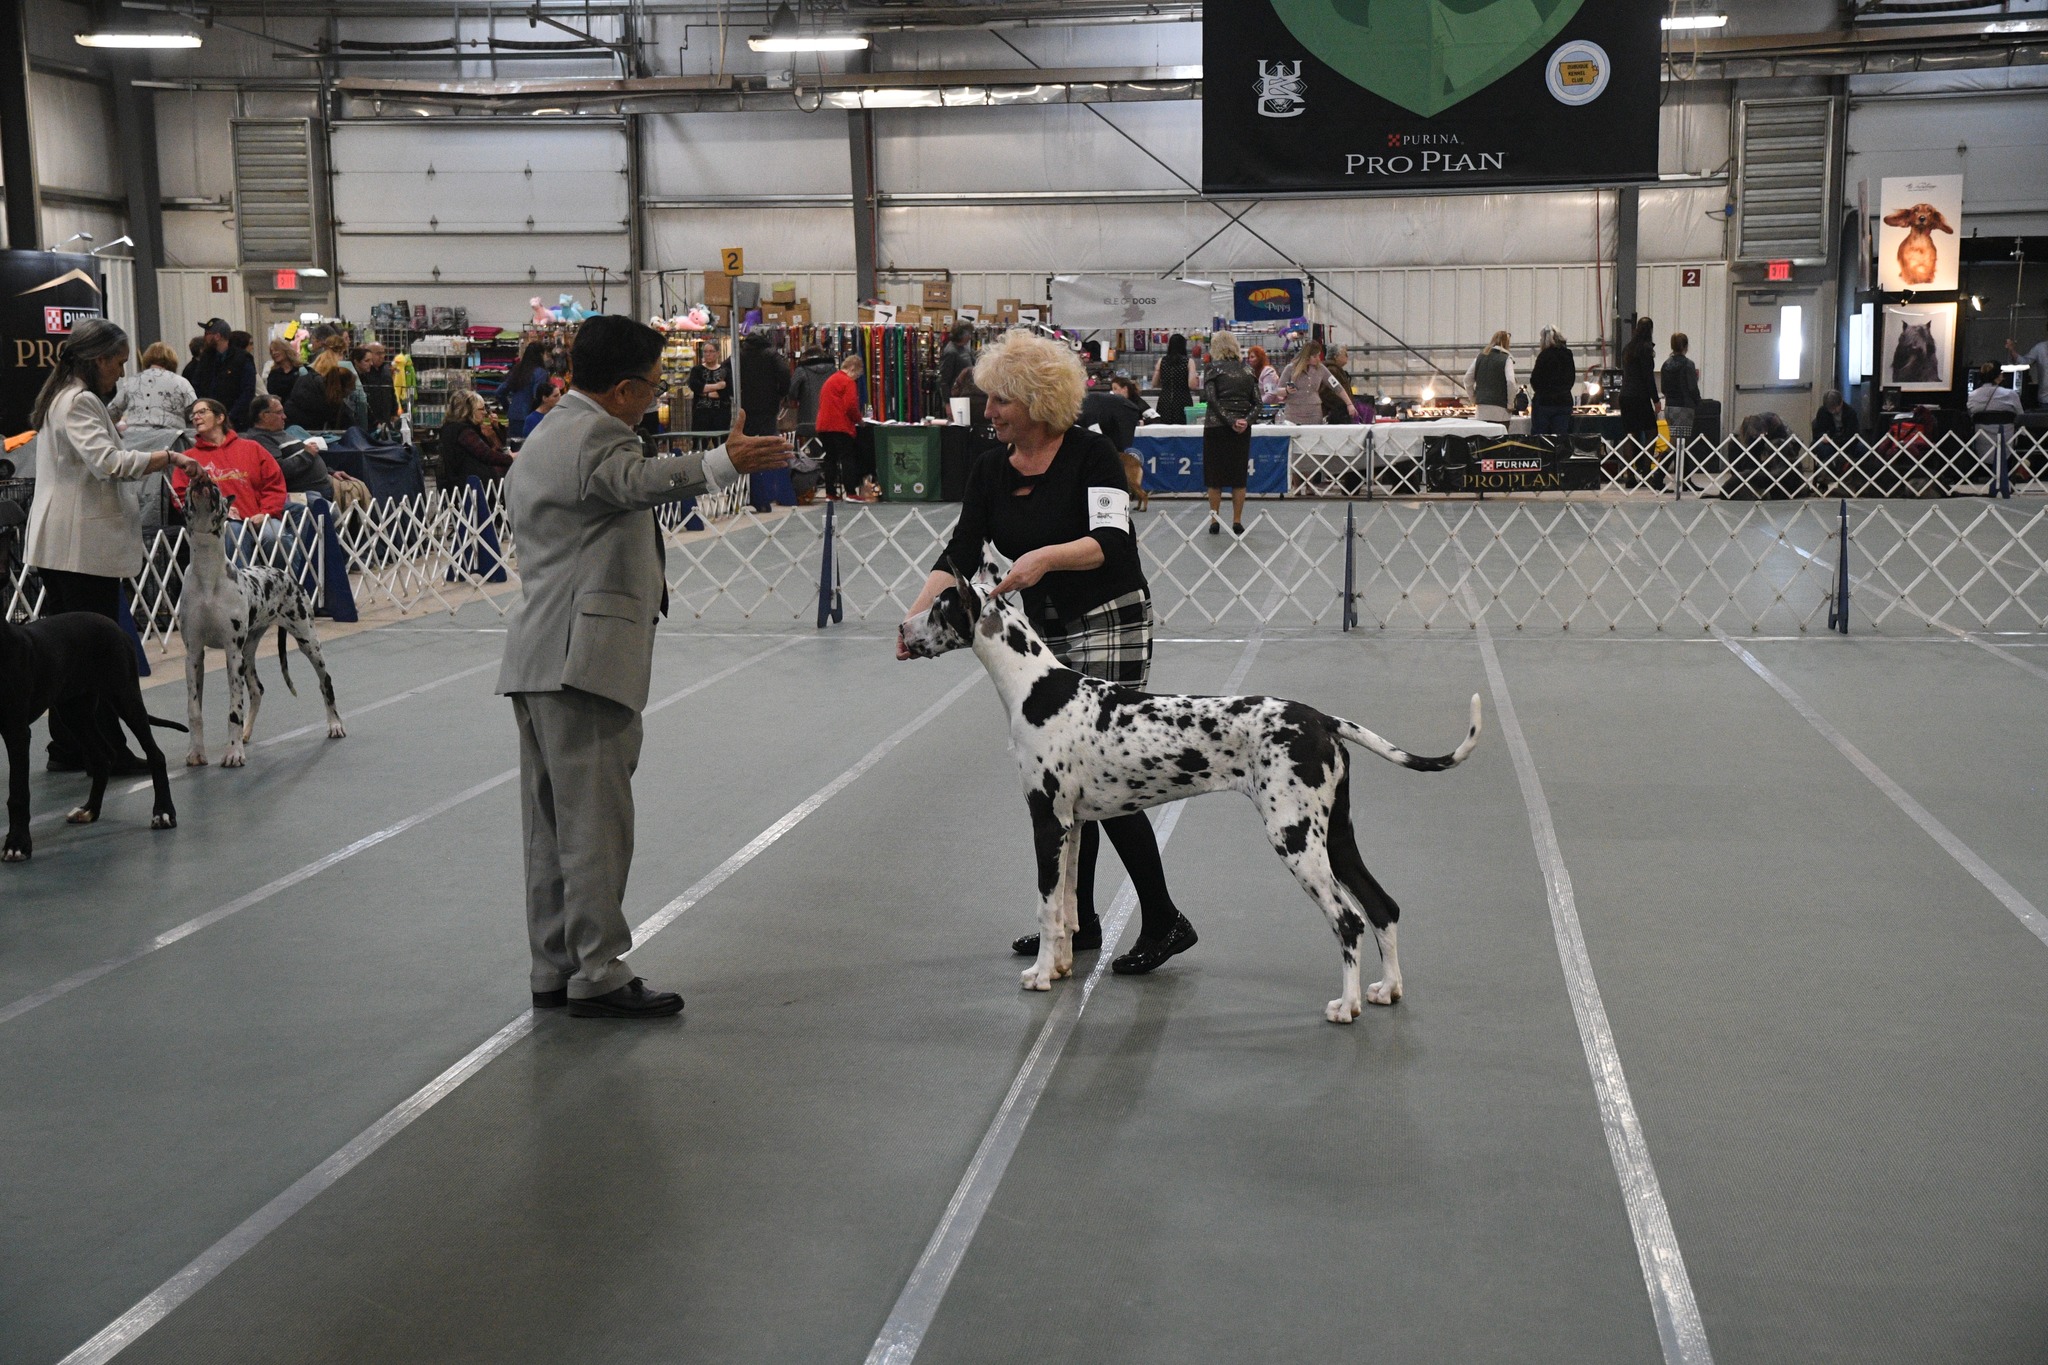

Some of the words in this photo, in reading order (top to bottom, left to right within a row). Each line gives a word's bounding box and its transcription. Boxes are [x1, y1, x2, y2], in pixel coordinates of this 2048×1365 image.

[1403, 134, 1459, 145] PURINA
[1345, 154, 1413, 176] PRO
[1421, 151, 1505, 172] PLAN
[727, 252, 739, 270] 2
[1687, 271, 1696, 284] 2
[1769, 264, 1789, 279] EXIT
[216, 278, 223, 290] 1
[1103, 297, 1119, 306] ISLE
[1120, 297, 1132, 306] OF
[1133, 297, 1157, 305] DOGS
[1147, 456, 1157, 474] 1
[1178, 457, 1191, 475] 2
[1496, 458, 1539, 469] PURINA
[1463, 473, 1504, 488] PRO
[1509, 472, 1561, 488] PLAN
